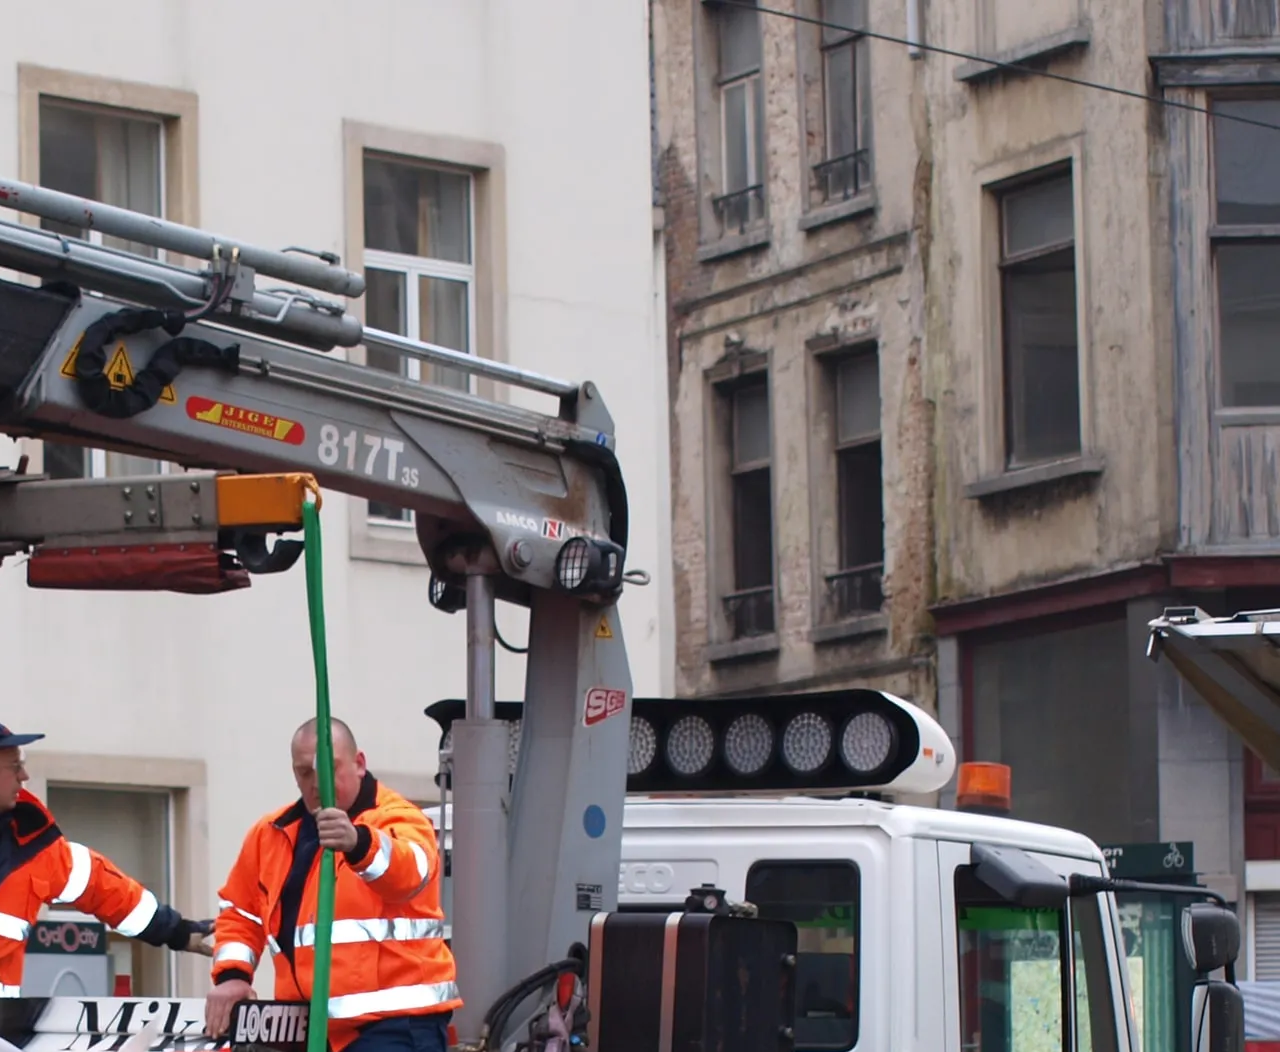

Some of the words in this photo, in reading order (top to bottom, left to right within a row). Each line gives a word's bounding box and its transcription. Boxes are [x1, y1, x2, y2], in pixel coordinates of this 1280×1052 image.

[224, 406, 276, 427] JIGE
[317, 423, 404, 481] 817T
[234, 1004, 308, 1044] LOCTITE
